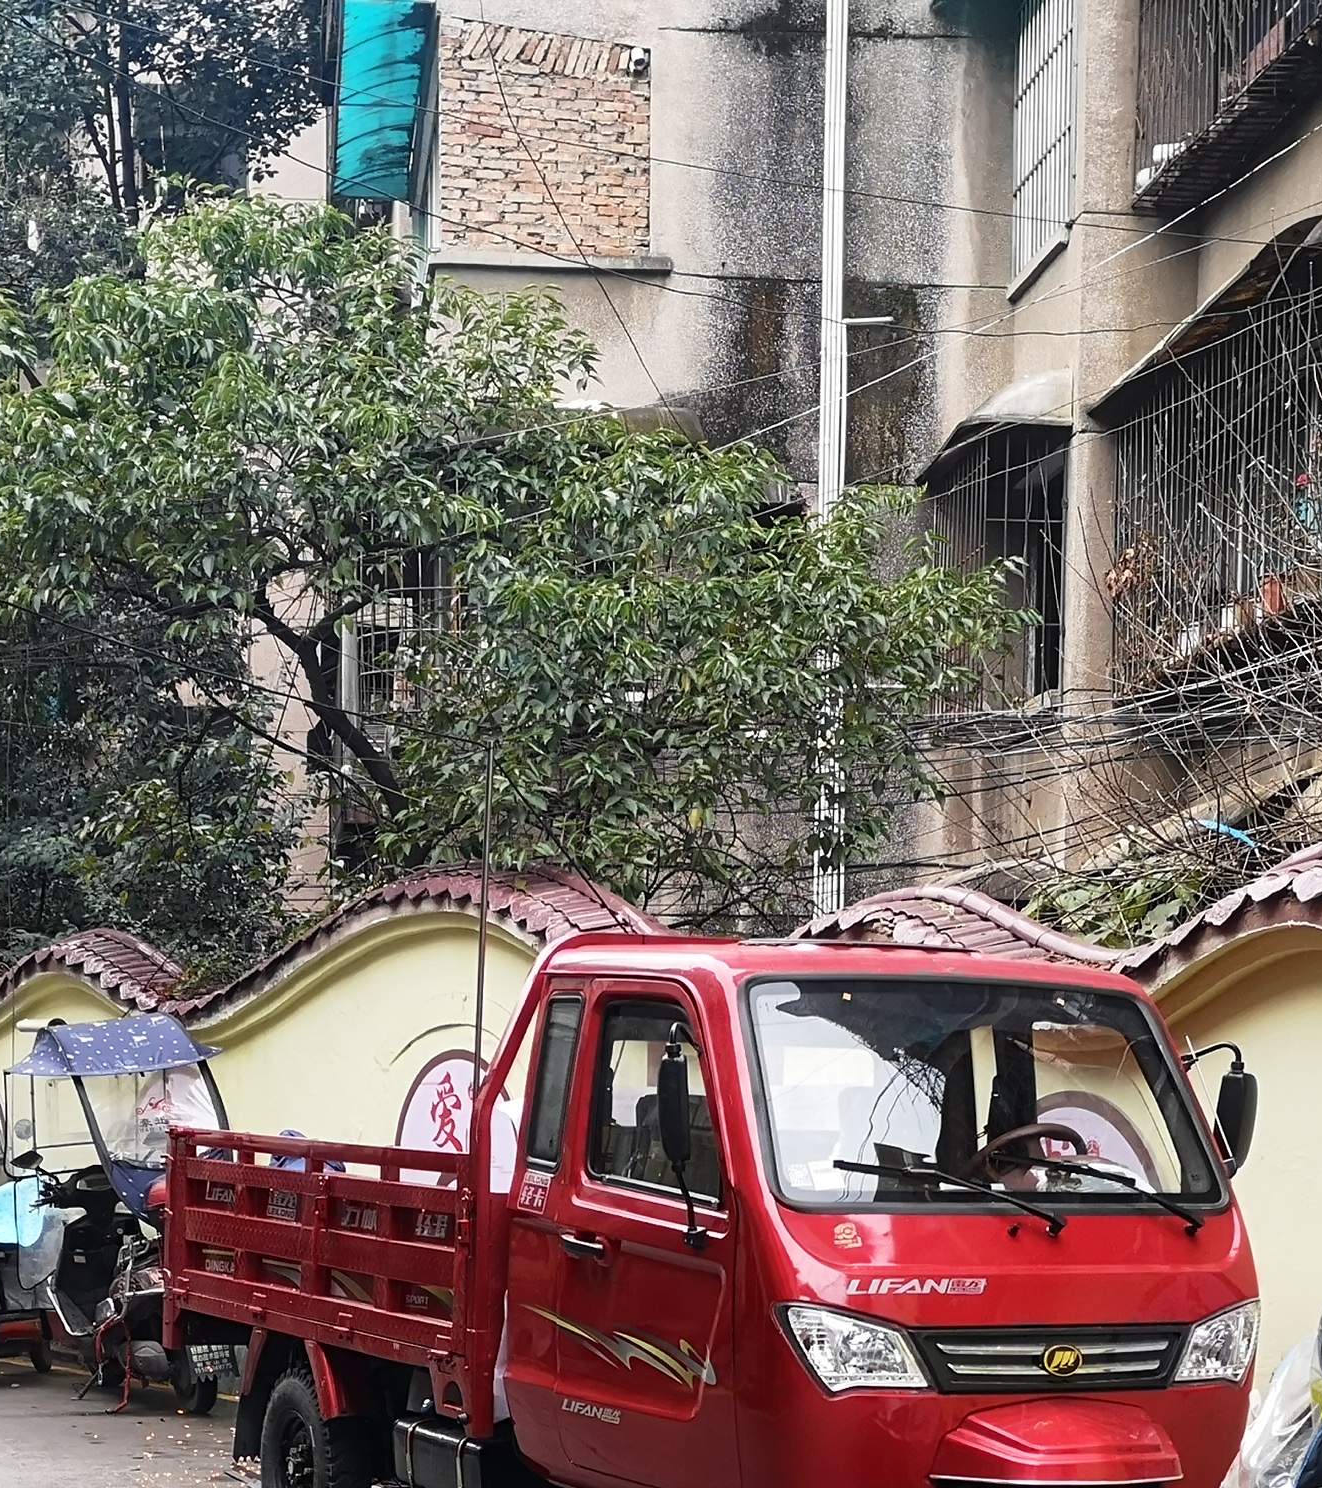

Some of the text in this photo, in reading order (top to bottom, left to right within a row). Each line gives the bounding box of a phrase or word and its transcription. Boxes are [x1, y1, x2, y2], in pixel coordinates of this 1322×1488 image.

[520, 1186, 546, 1208] 轻卡
[846, 1278, 951, 1295] LIFAN
[405, 1294, 429, 1306] SPORT
[561, 1398, 603, 1419] LIFAN
